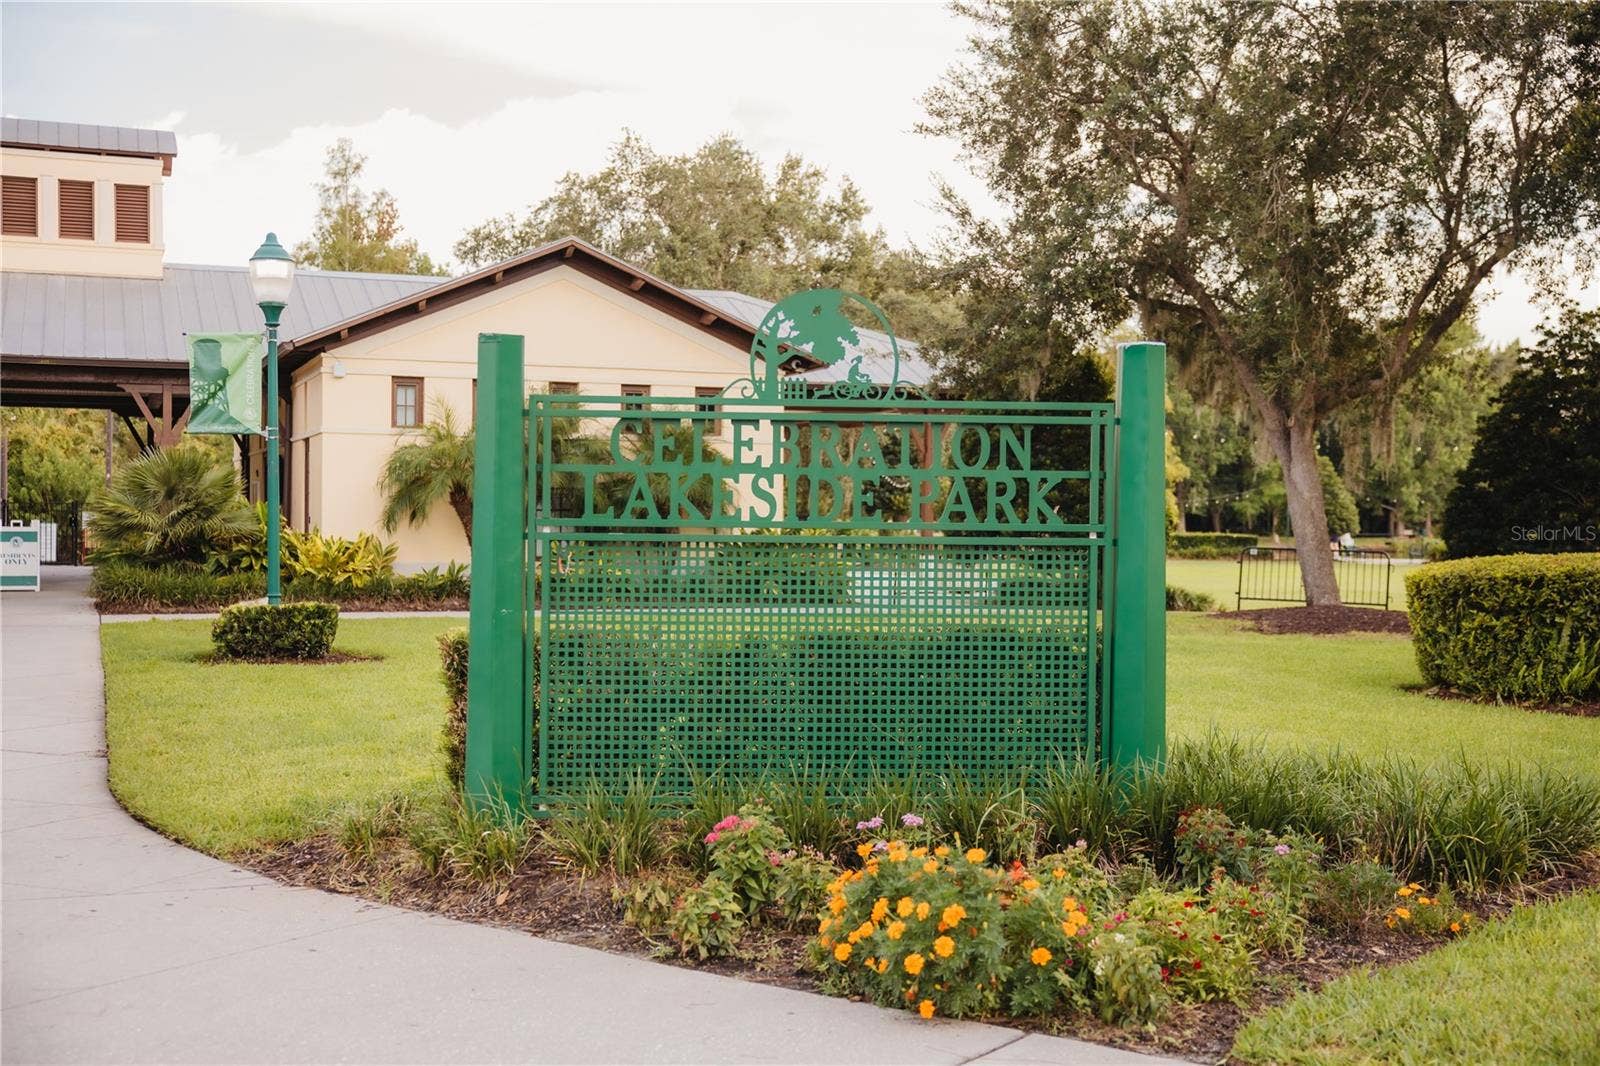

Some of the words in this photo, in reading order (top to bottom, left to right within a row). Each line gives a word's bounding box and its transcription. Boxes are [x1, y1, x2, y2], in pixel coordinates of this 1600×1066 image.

[610, 417, 1034, 471] CELEBRATION
[581, 470, 883, 523] LAKESIDE
[906, 474, 1066, 525] PARK
[4, 558, 28, 566] ONLY
